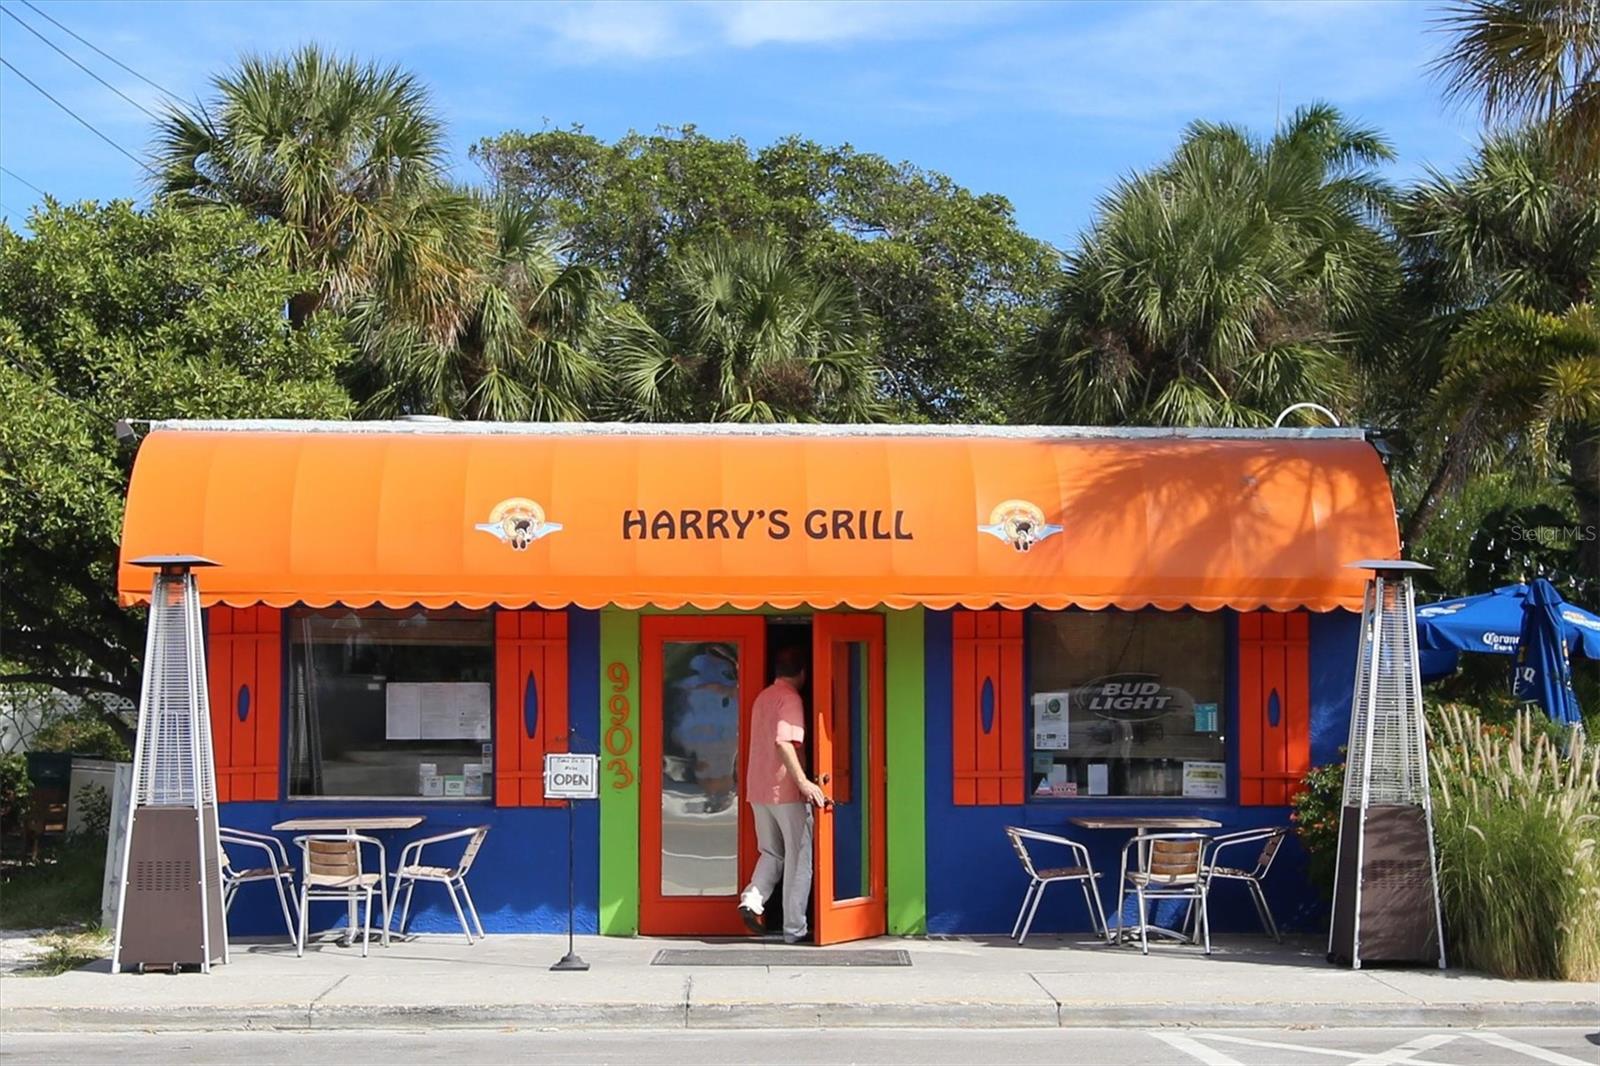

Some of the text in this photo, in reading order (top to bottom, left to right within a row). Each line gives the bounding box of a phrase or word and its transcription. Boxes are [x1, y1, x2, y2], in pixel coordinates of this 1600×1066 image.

[622, 509, 913, 540] HARRY'S GRILL
[1102, 682, 1160, 695] BUD
[1089, 696, 1171, 710] LIGHT
[606, 662, 633, 788] 9903
[553, 773, 588, 785] OPEN
